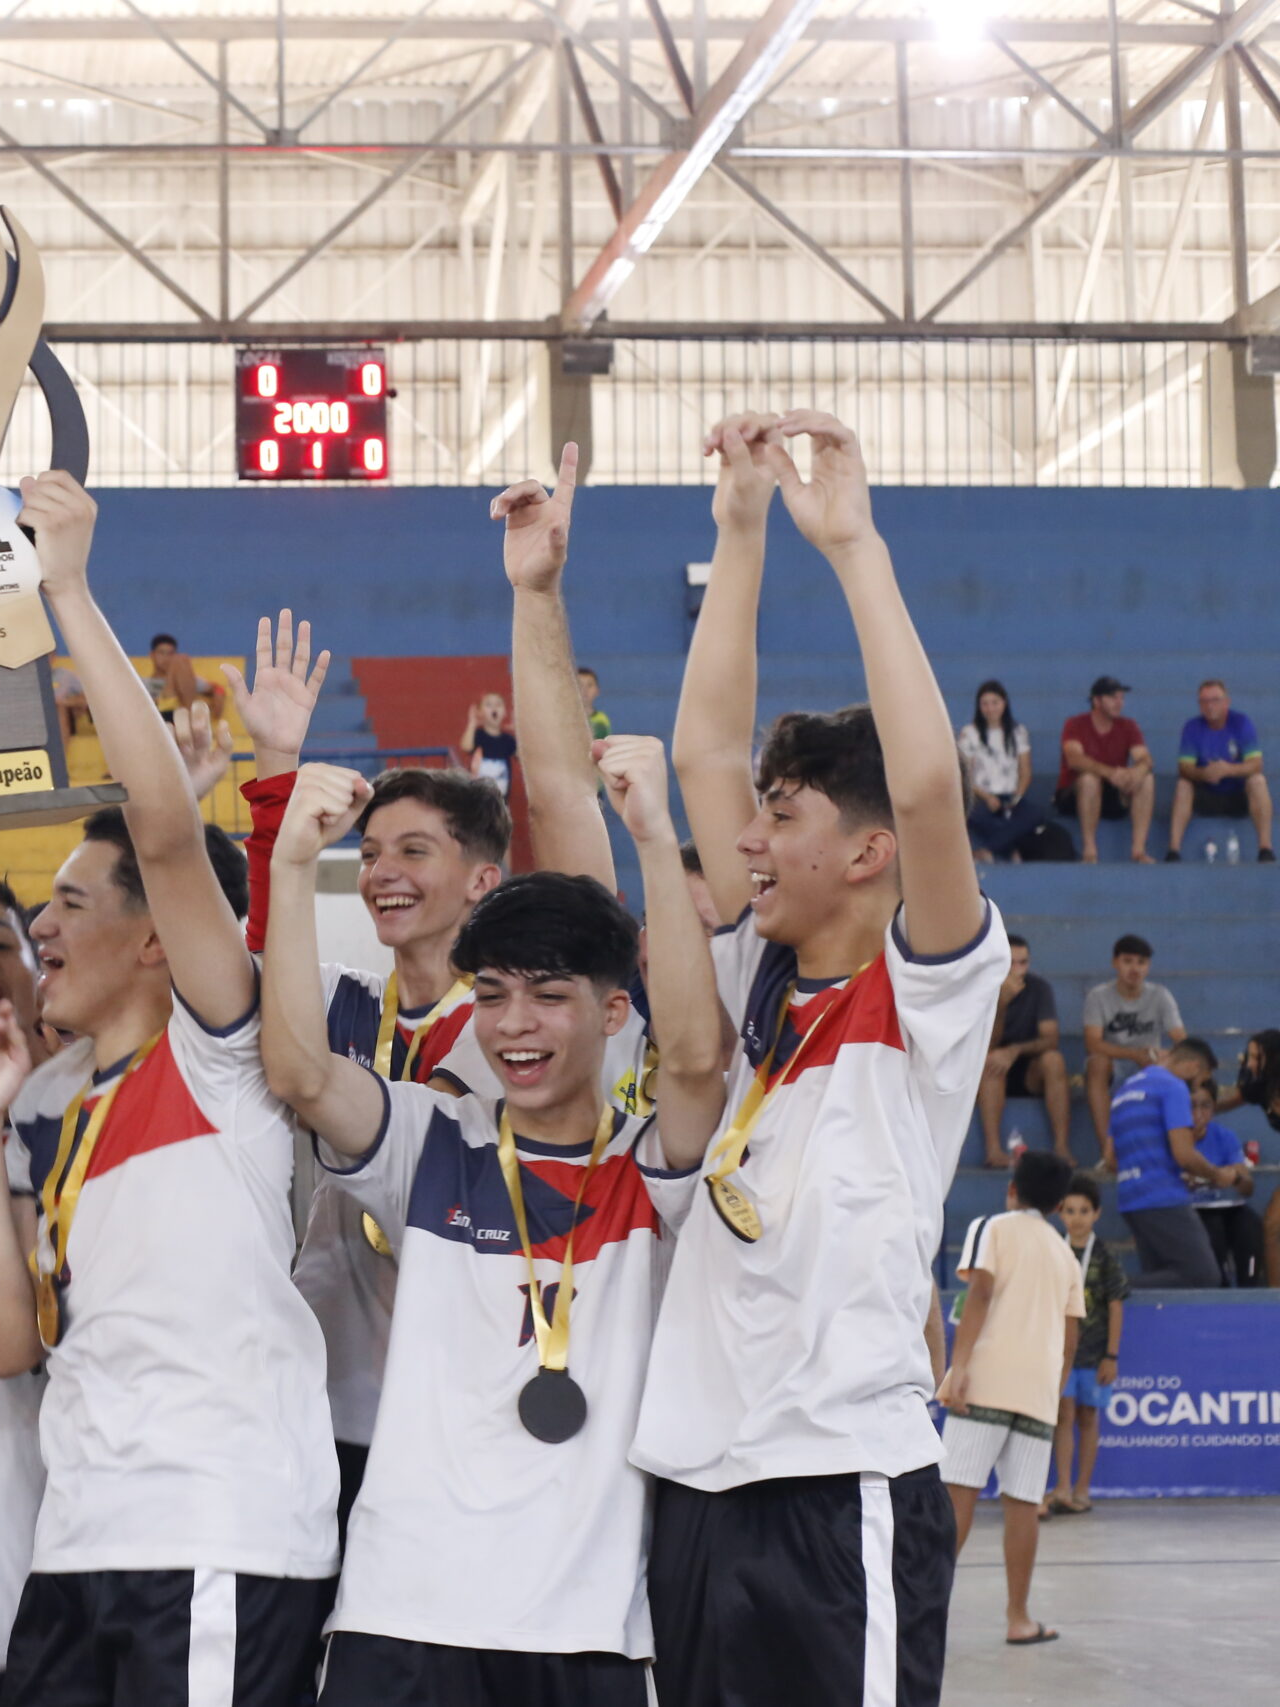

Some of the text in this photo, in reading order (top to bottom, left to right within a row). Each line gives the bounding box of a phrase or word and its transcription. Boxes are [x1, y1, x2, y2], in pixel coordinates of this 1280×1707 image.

[258, 364, 278, 398] 0
[362, 363, 382, 396] 0
[273, 401, 350, 434] 2000
[259, 439, 280, 472] 0
[312, 441, 323, 470] 1
[363, 438, 384, 471] 0
[476, 1228, 512, 1242] CRUZ
[1157, 1375, 1182, 1389] DO
[1181, 1435, 1190, 1447] E
[1191, 1434, 1263, 1447] CUIDANDO
